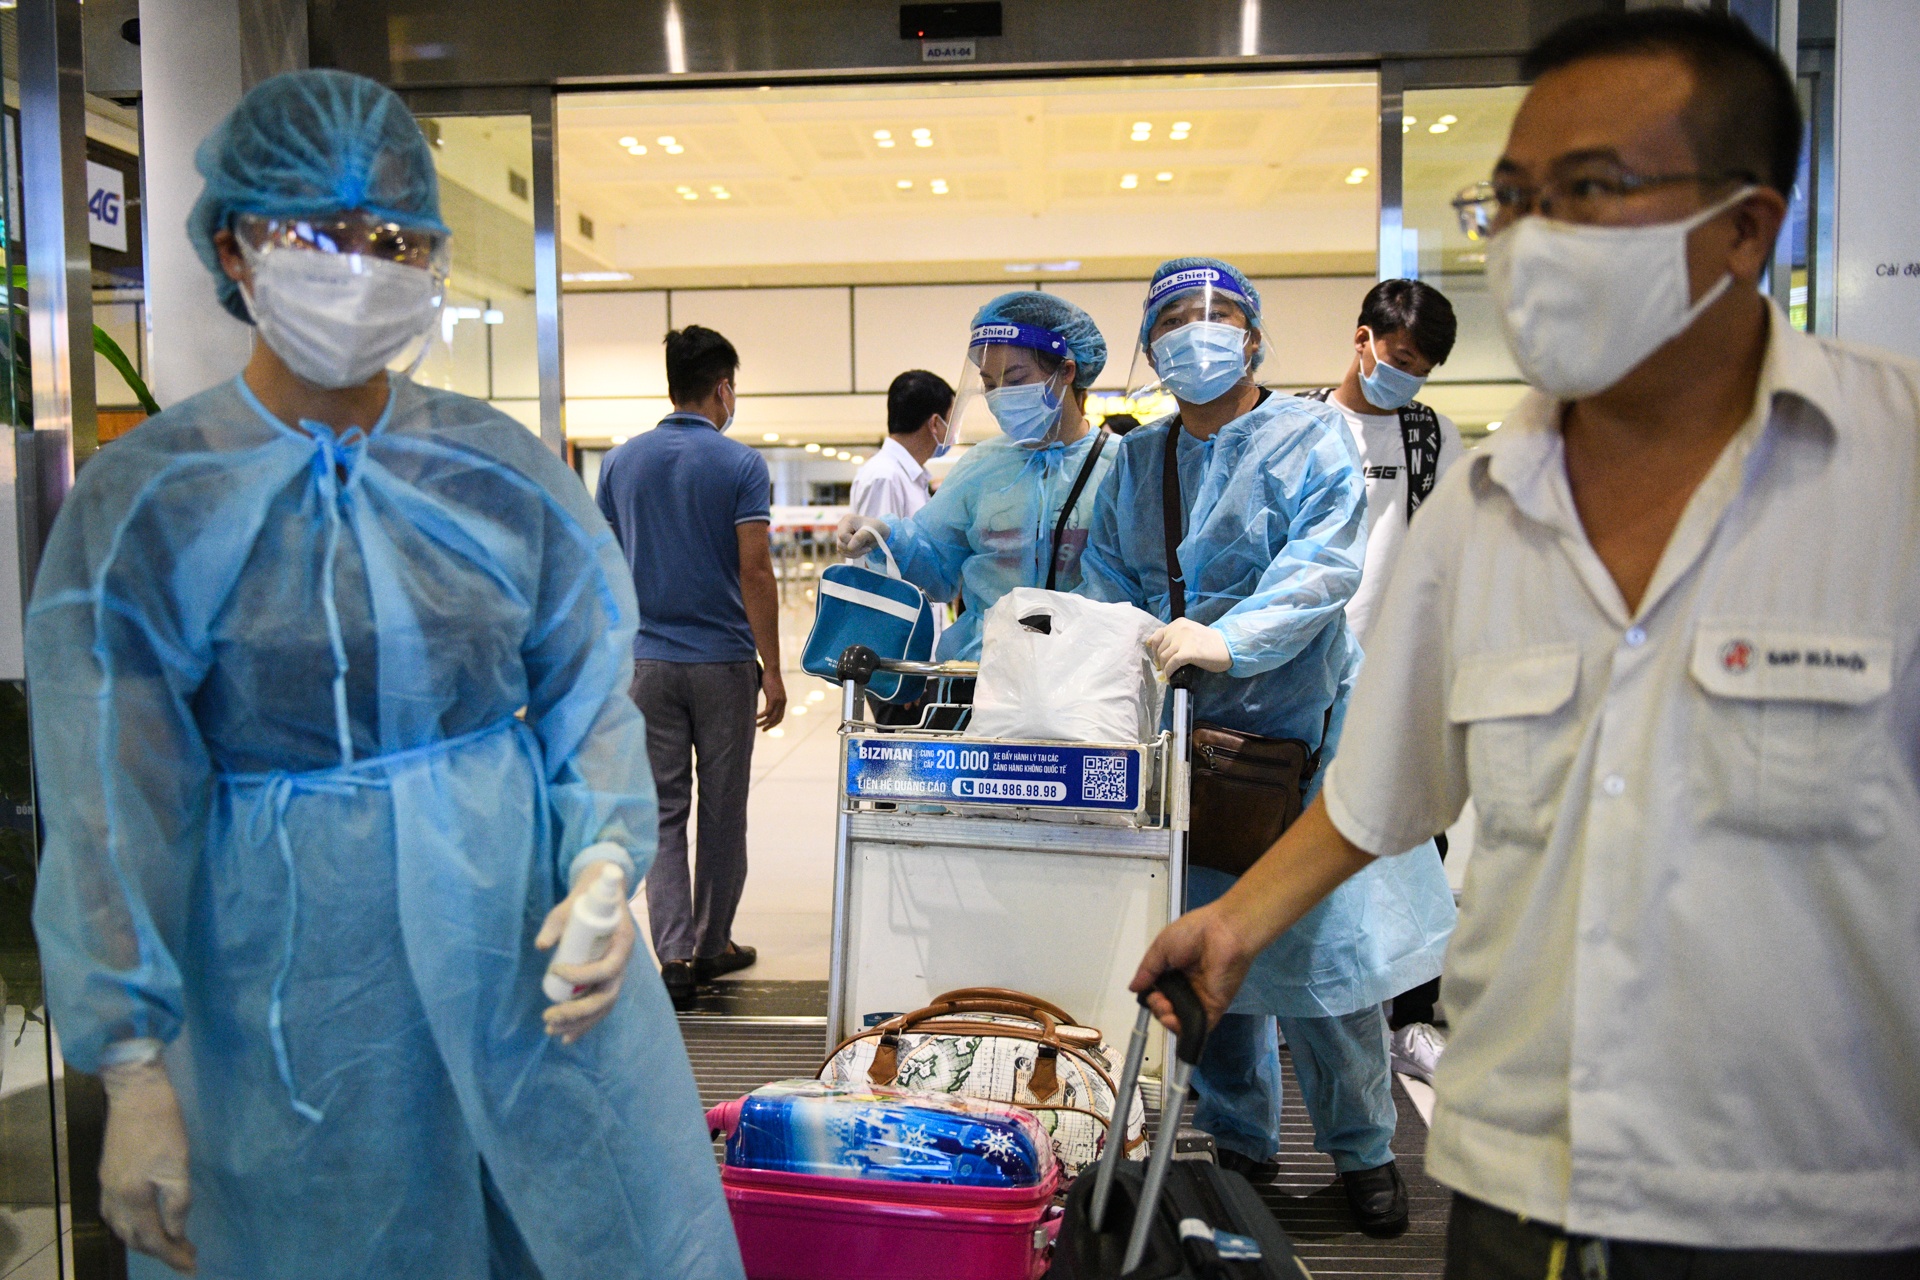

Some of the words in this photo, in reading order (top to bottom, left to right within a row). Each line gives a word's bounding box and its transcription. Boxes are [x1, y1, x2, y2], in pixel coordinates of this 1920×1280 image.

[927, 47, 971, 57] AD-A1-04
[88, 188, 120, 225] 4G
[1152, 279, 1173, 295] Face
[1177, 271, 1214, 282] Shield
[982, 328, 1013, 336] Shield
[859, 747, 912, 761] BIZMAN
[936, 750, 989, 771] 20.000
[993, 752, 1000, 760] XE
[1014, 752, 1028, 761] HÀNH
[1030, 753, 1037, 761] LÝ
[1038, 754, 1046, 763] TẠI
[1047, 753, 1059, 762] CÁC
[1008, 763, 1023, 772] HÀNG
[1024, 764, 1043, 773] KHÔNG
[858, 777, 878, 789] LIÊN
[927, 780, 946, 793] CÁO
[978, 782, 1057, 798] 094.986.98.98
